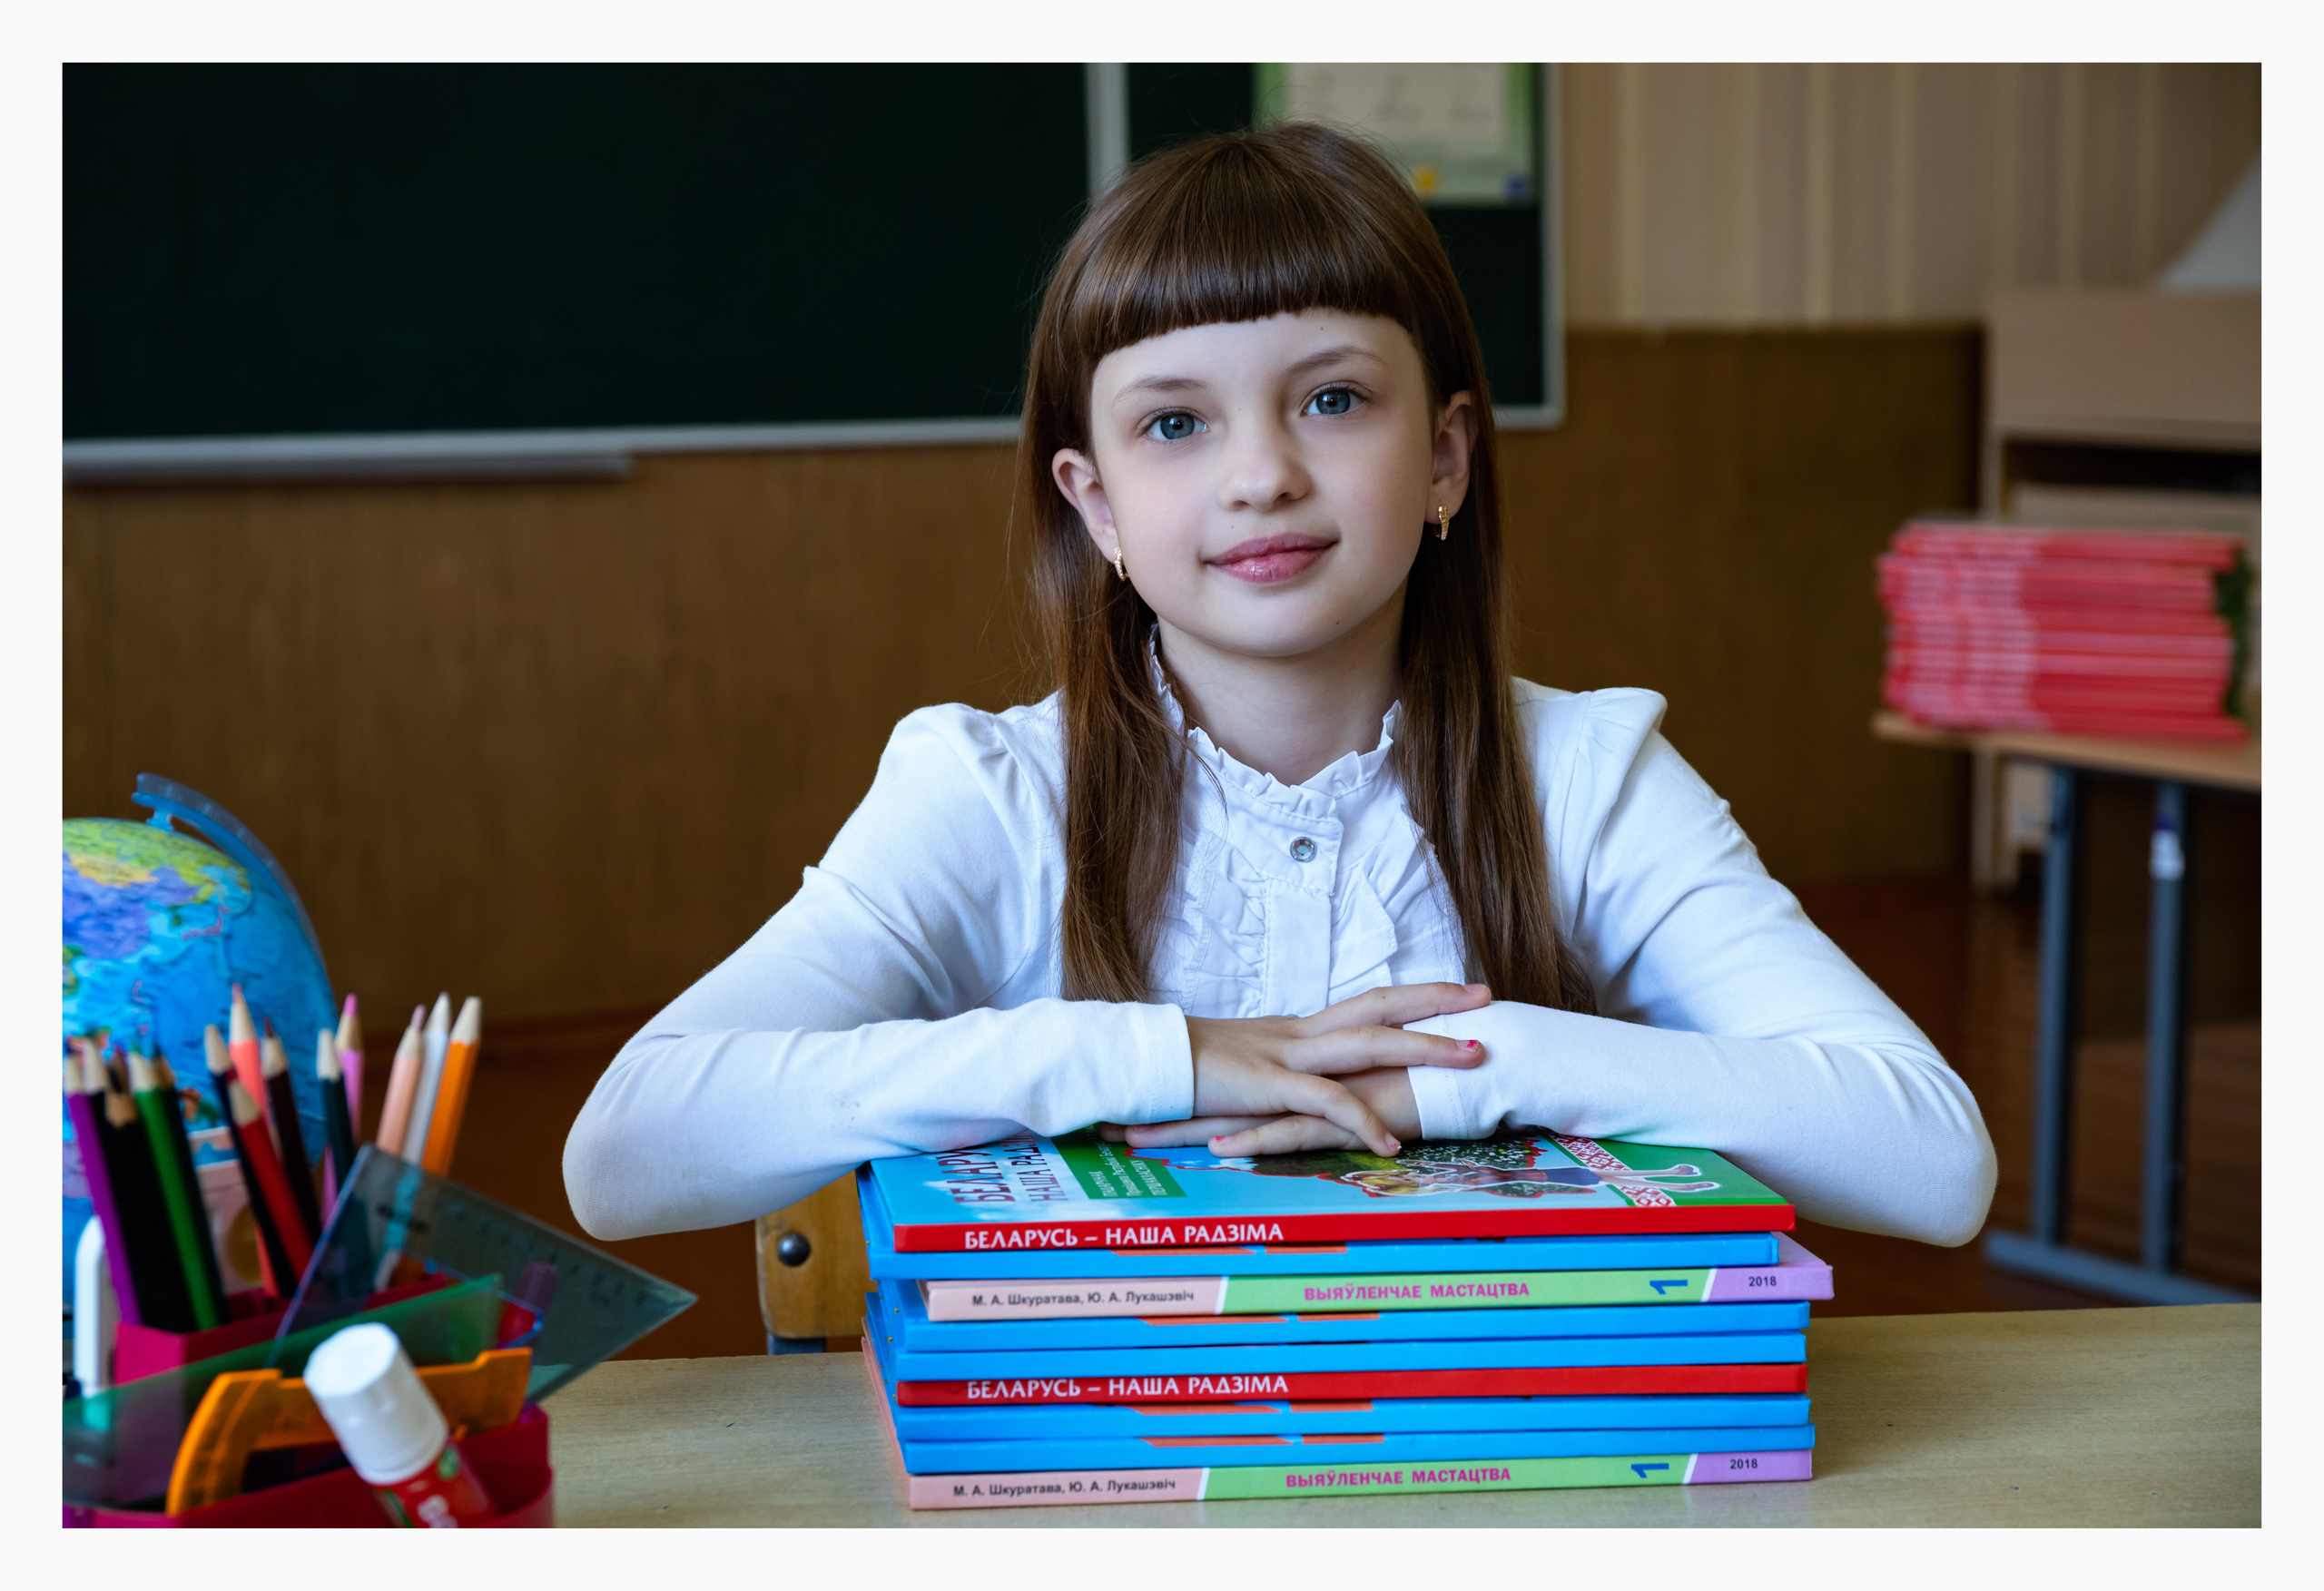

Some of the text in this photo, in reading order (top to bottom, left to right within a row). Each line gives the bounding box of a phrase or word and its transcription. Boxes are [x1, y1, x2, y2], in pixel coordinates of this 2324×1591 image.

[935, 1149, 1016, 1203] БЕЛАРУ
[1016, 1168, 1069, 1203] НАША
[964, 1228, 1078, 1250] БЕЛАРУСЬ
[1106, 1226, 1177, 1246] НАША
[1184, 1223, 1284, 1243] РАДЗІМА
[1304, 1282, 1530, 1301] ВЫЯЎЛЕНЧАЕ МАСТАЦТВА
[1649, 1279, 1688, 1295] 1
[1748, 1276, 1777, 1288] 2018
[972, 1291, 1195, 1307] М. А. Шкуратава, Ю. А. Лукашэвіч
[967, 1378, 1081, 1399] БЕЛАРУСЬ
[1108, 1377, 1179, 1397] НАША
[1187, 1375, 1289, 1395] РАДЗІМА
[1630, 1462, 1669, 1478] 1
[1729, 1458, 1758, 1470] 2018
[1285, 1467, 1512, 1488] ВЫЯЎЛЕНЧАЕ МАСТАЦТВА
[953, 1478, 1177, 1497] М. А. Шкуратава, Ю. А. Лукашэвіч
